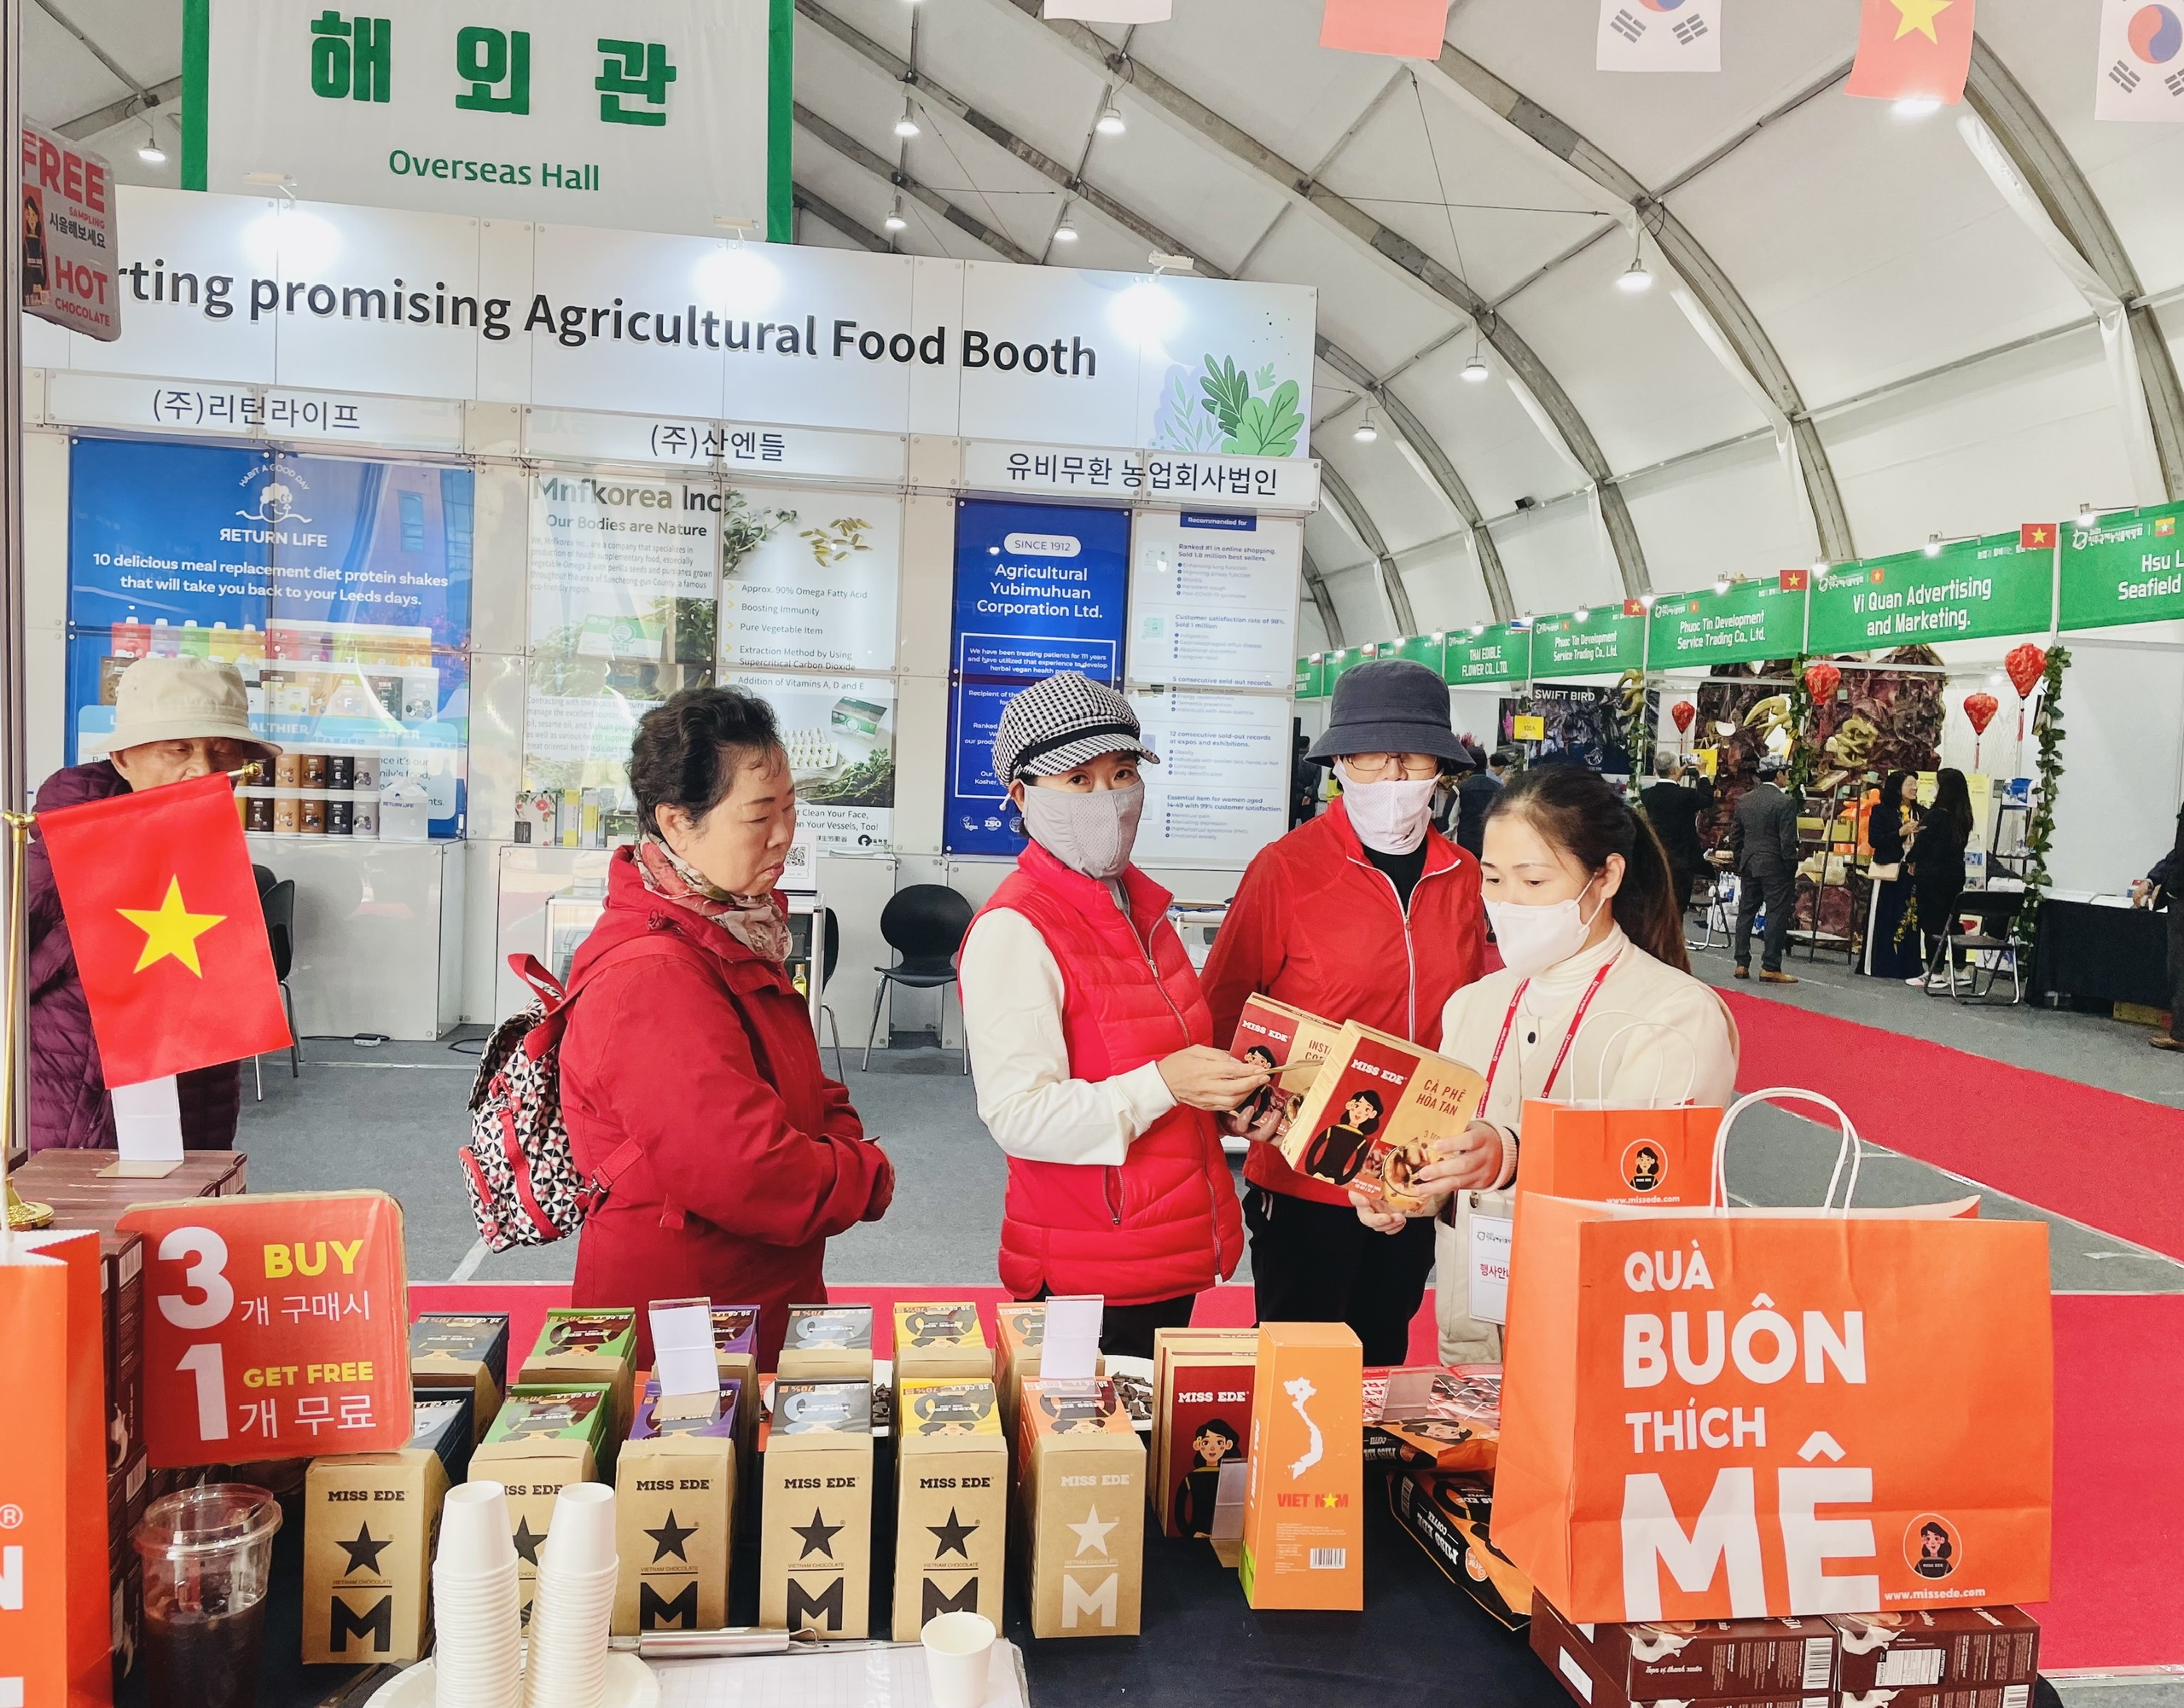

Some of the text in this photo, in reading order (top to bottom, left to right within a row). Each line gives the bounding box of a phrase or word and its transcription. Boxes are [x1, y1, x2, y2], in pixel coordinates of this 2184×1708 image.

[22, 129, 105, 213] FREE
[388, 149, 600, 191] Overseas Hall
[69, 206, 105, 229] SAMPLING
[49, 212, 106, 249] 시음해보세요
[55, 256, 108, 305] HOT
[55, 298, 110, 327] CHOCOLATE
[119, 259, 1096, 377] ting promising Agricultural Food Booth
[239, 468, 259, 487] HABIT
[271, 464, 294, 481] GOOD
[294, 474, 311, 491] DAY
[1007, 452, 1277, 497] 유비무환 농업회사법인
[546, 514, 707, 537] Our Bodies are Nature
[1188, 517, 1236, 526] Recommended
[293, 532, 328, 548] LIFE
[1014, 540, 1071, 552] SINCE 1912
[93, 553, 449, 588] 10 delicious meal replacement diet protein shakes
[2142, 553, 2170, 572] Hsu
[995, 564, 1088, 582] Agricultural
[120, 575, 422, 607] that will take you back to your Leeds days.
[742, 584, 868, 599] Approx. 90% Omega Fatty Acid
[990, 582, 1091, 599] Yubimuhuan
[1853, 577, 1992, 613] Vi Quan Advertising
[2118, 573, 2181, 600] Seafield
[742, 603, 820, 617] Boosting Immunity
[977, 600, 1103, 619] Corporation Ltd.
[741, 622, 823, 636] Pure Vegetable Item
[1680, 609, 1764, 633] Phuoc Tin Development
[1867, 607, 1971, 636] and Marketing.
[1677, 636, 1704, 650] Service
[1705, 632, 1732, 647] Trading
[1750, 627, 1765, 641] Ltd.
[740, 646, 852, 660] Extraction Method by Using
[1482, 646, 1501, 659] EDIBLE
[739, 657, 856, 671] Supercritical Carbon Dioxide
[1462, 663, 1484, 677] FLOWER
[738, 676, 773, 687] Addition
[775, 677, 784, 687] of
[786, 678, 821, 689] Vitamins
[841, 681, 857, 689] and
[1536, 689, 1595, 701] SWIFT BIRD
[802, 809, 825, 817] Clean
[848, 810, 868, 820] Face,
[827, 822, 858, 831] Vessels,
[1242, 1020, 1266, 1035] MISS
[1351, 1059, 1380, 1077] MISS
[1424, 1079, 1467, 1101] CÀ PHÊ
[1416, 1093, 1458, 1116] HÒA TAN
[1606, 1194, 1680, 1205] www.missede.com
[1624, 1240, 1714, 1293] QUÀ
[157, 1226, 364, 1329] 3 BUY
[241, 1289, 370, 1327] 개 구매시
[1624, 1293, 1867, 1388] BUÔN
[175, 1343, 374, 1442] 1 GET FREE
[1178, 1391, 1213, 1403] MISS
[239, 1393, 378, 1439] 개 무료
[1625, 1397, 1766, 1454] THÍCH
[636, 1480, 675, 1491] MISS
[784, 1479, 822, 1489] MISS
[920, 1479, 957, 1489] MISS
[1061, 1475, 1096, 1486] MISS
[328, 1490, 369, 1502] MISS
[1277, 1494, 1309, 1508] VIET
[1621, 1431, 1879, 1621] MÊ
[1885, 1587, 1986, 1601] www.missede.com
[330, 1595, 392, 1653] M
